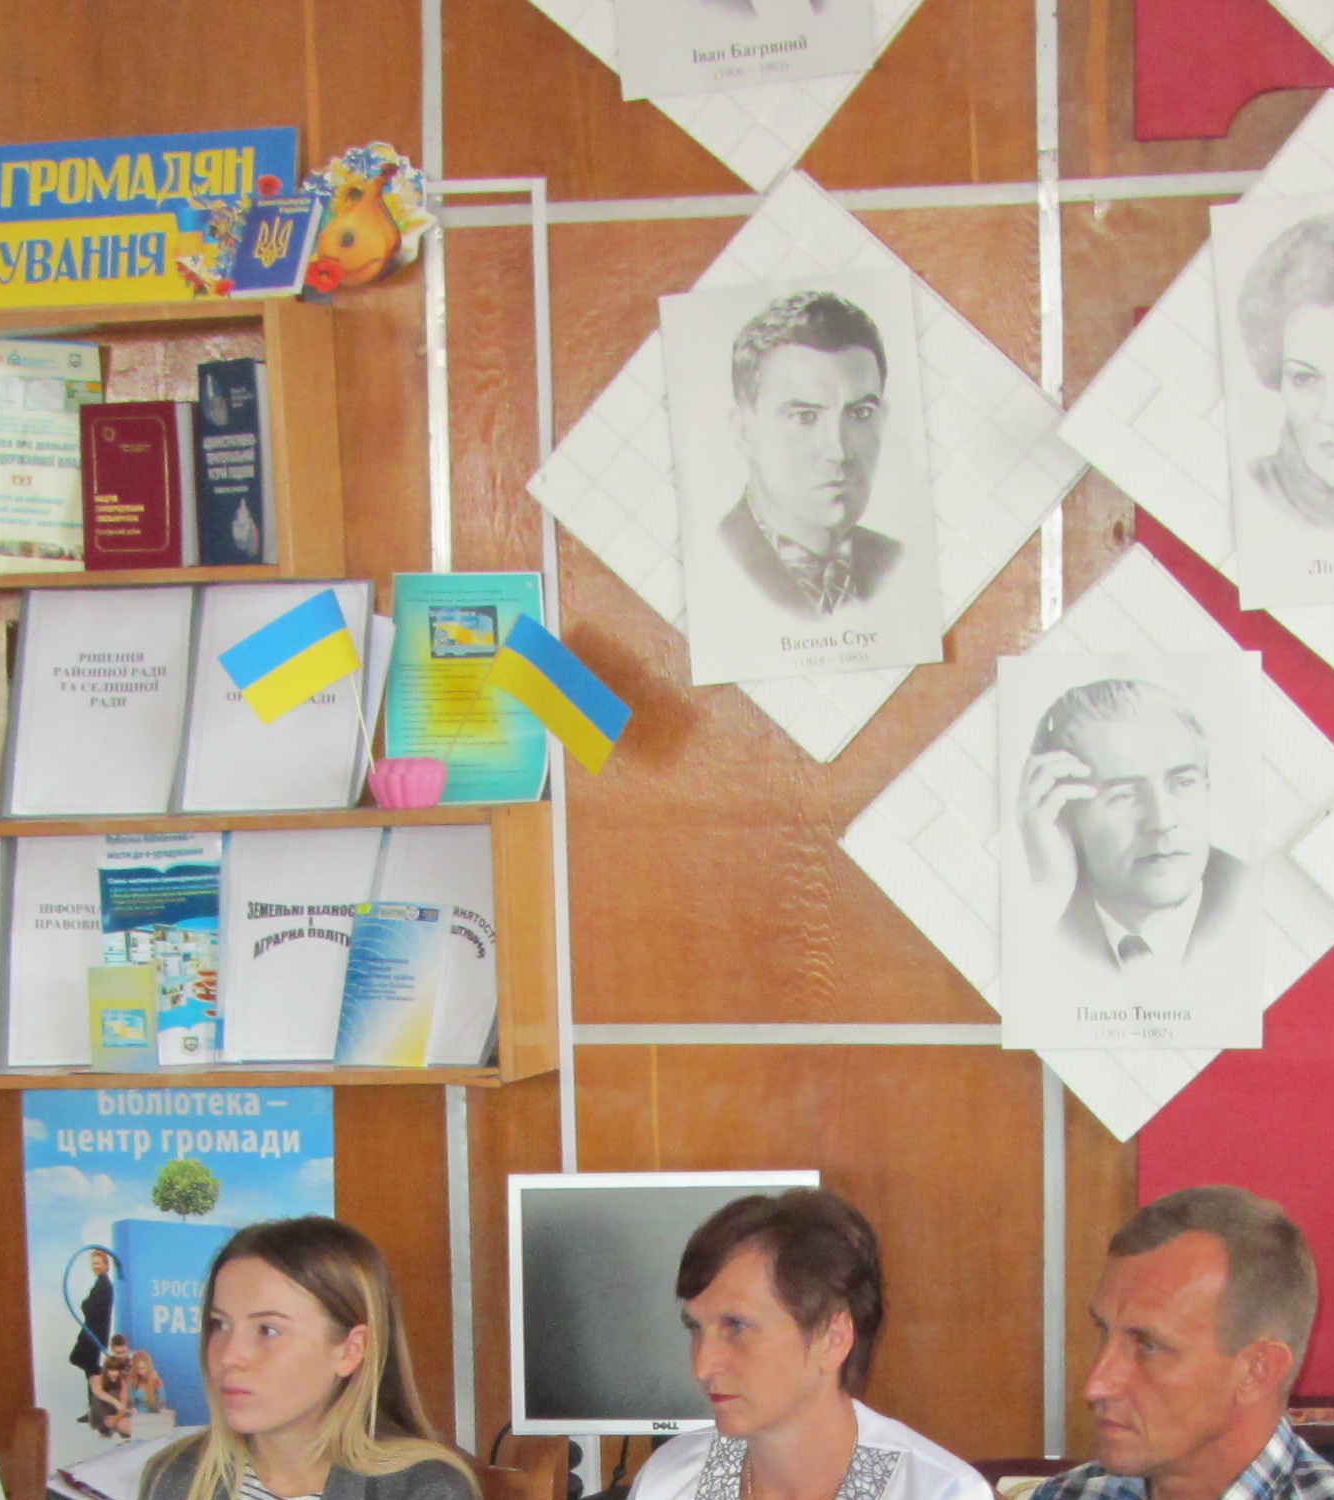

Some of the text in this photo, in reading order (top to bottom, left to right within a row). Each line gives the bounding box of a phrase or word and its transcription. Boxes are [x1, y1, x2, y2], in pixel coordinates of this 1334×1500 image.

[692, 34, 807, 63] Іван Багряний
[0, 146, 256, 211] ГРОМАДЯН
[781, 631, 878, 651] Василь Стус
[53, 666, 166, 678] РАЙОННОЇ РАДИ
[60, 682, 77, 692] ТА
[90, 697, 126, 708] РАДИ
[40, 904, 101, 914] ІНФОРМ
[247, 901, 356, 919] ЗЕМЕЛЬНІ ВІДНОС
[452, 905, 496, 945] ЙНЯТОСТ
[254, 928, 304, 959] АГРАРНА
[1076, 1006, 1192, 1021] Павло Тичина
[57, 1128, 300, 1160] центр громади
[652, 1421, 679, 1430] DELL
